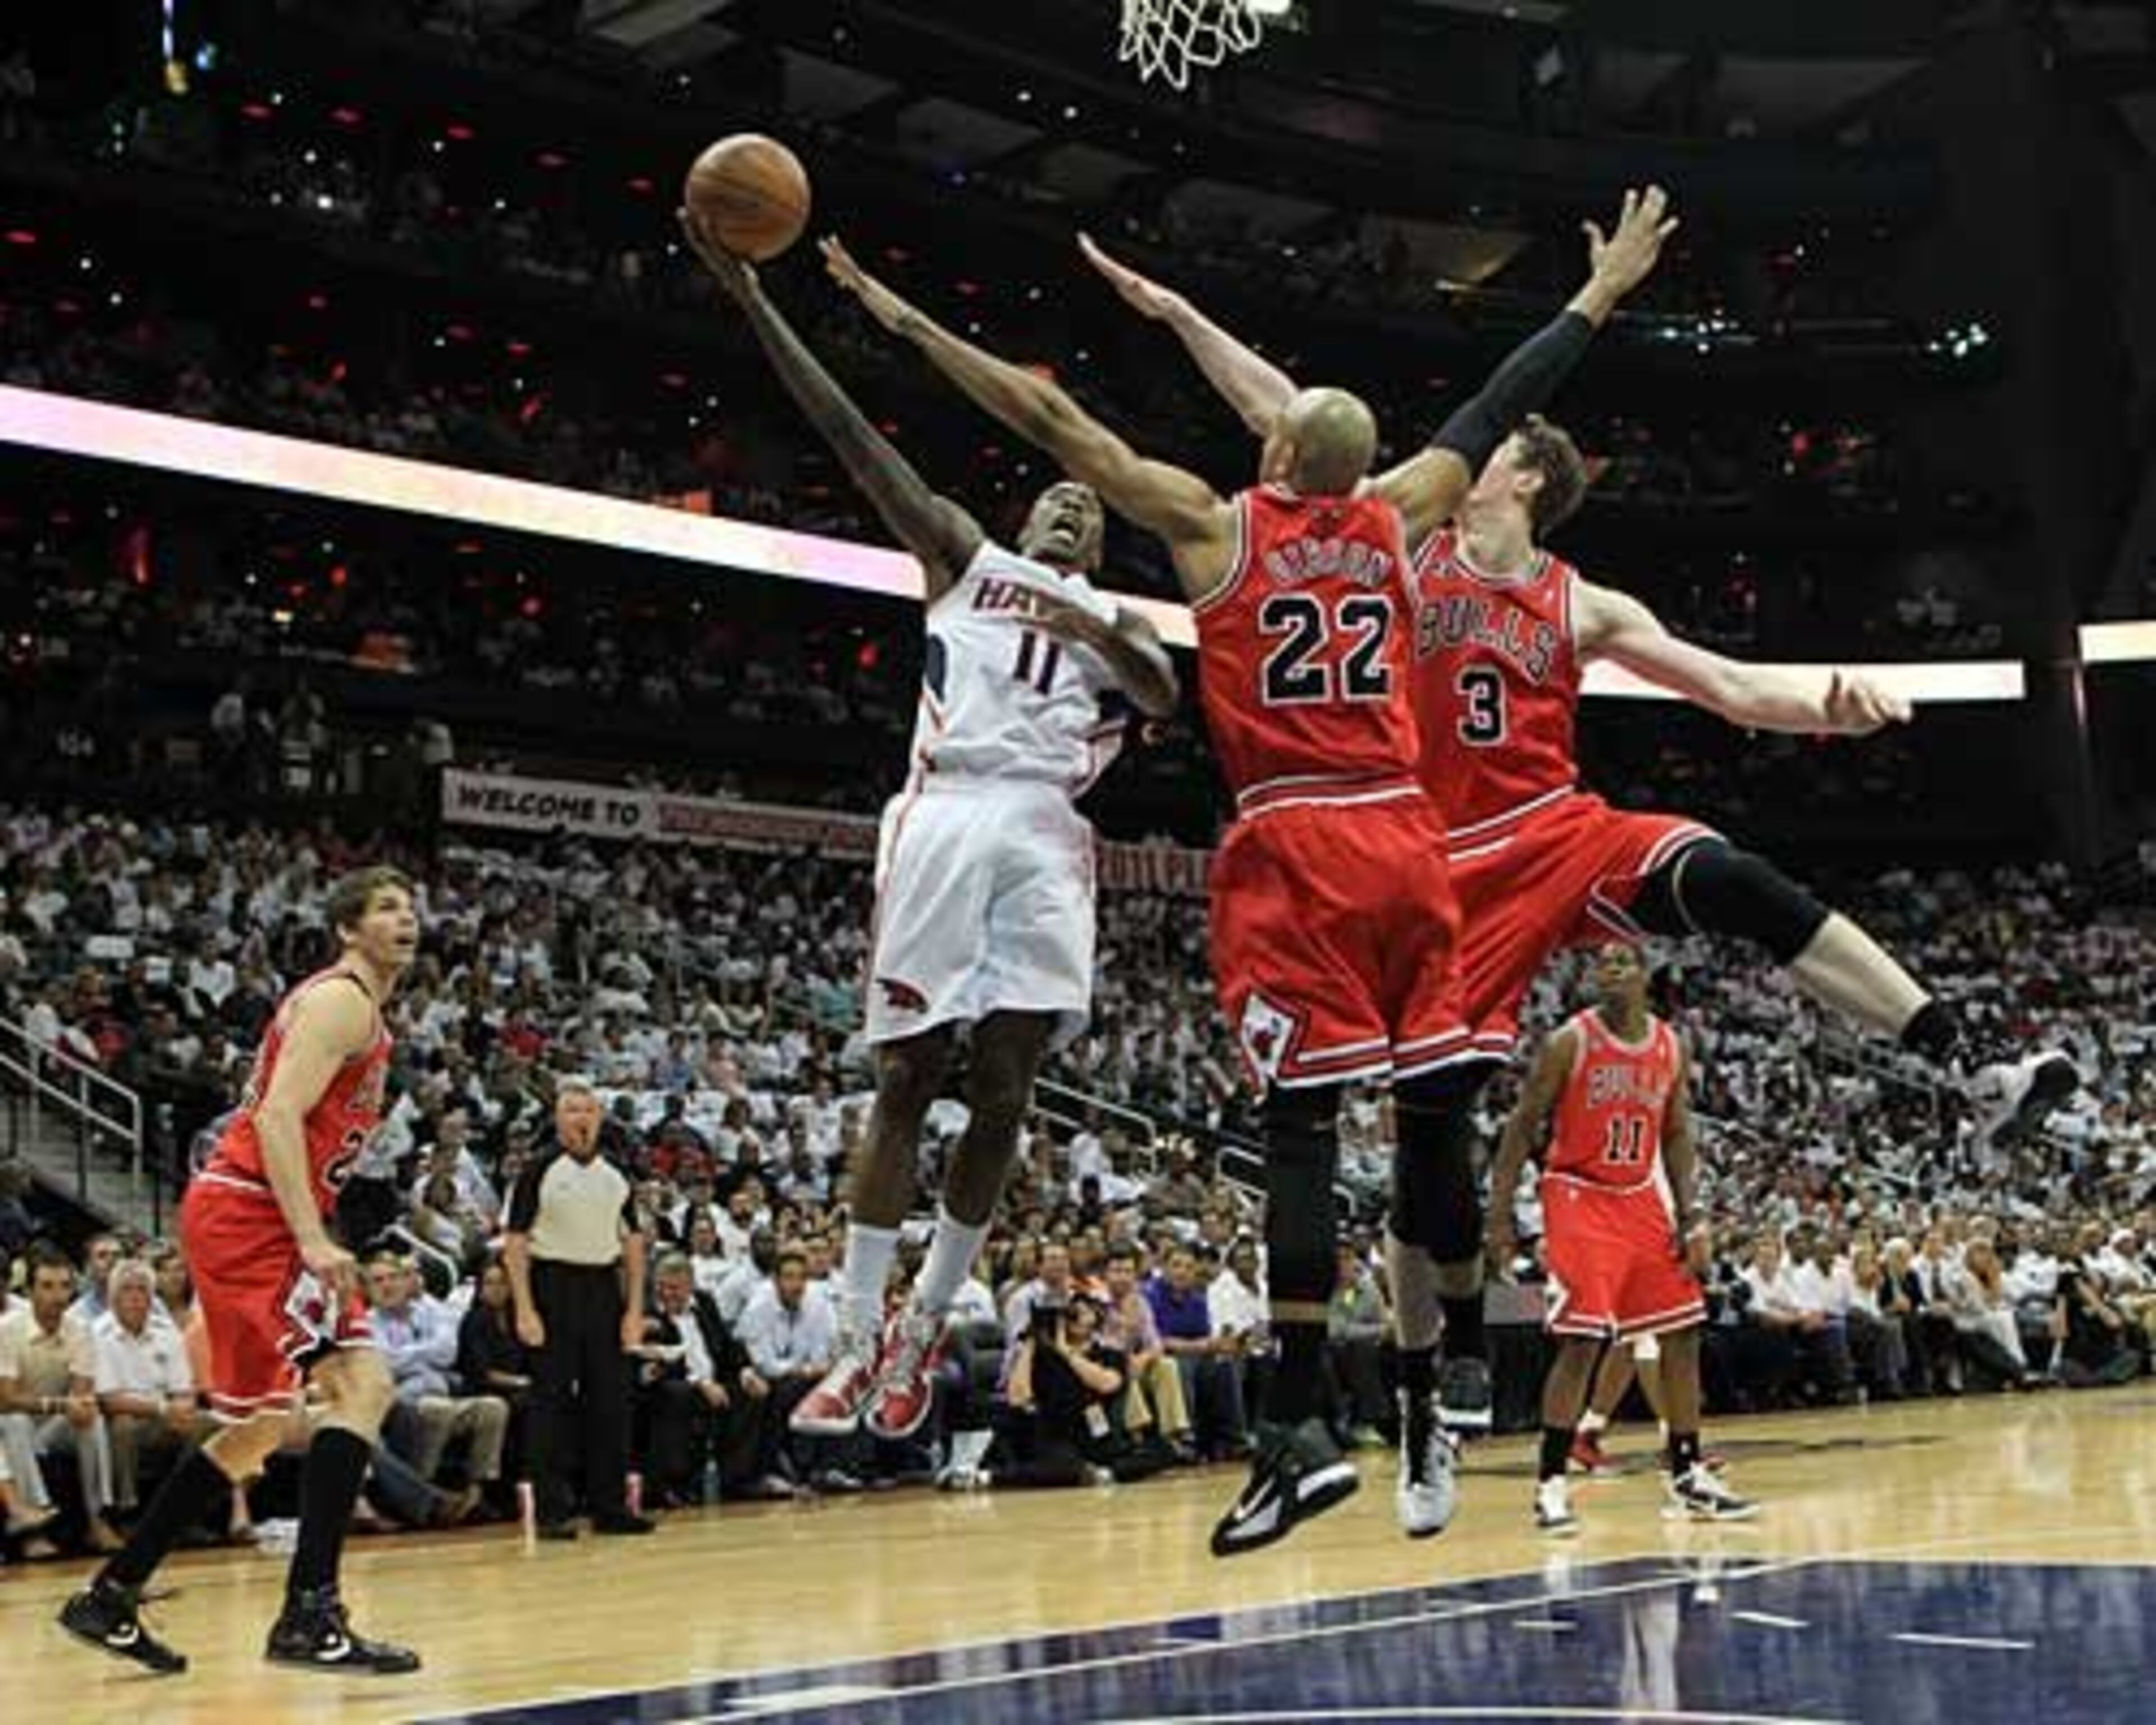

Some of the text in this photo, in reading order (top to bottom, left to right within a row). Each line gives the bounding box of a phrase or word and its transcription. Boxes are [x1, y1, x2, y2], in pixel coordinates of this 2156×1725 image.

[1012, 629, 1062, 697] 11
[1258, 591, 1393, 707] 22
[1415, 595, 1557, 686] BULLS
[1454, 663, 1508, 748] 3
[459, 785, 640, 827] WELCOME TO
[1603, 1112, 1649, 1166] 11
